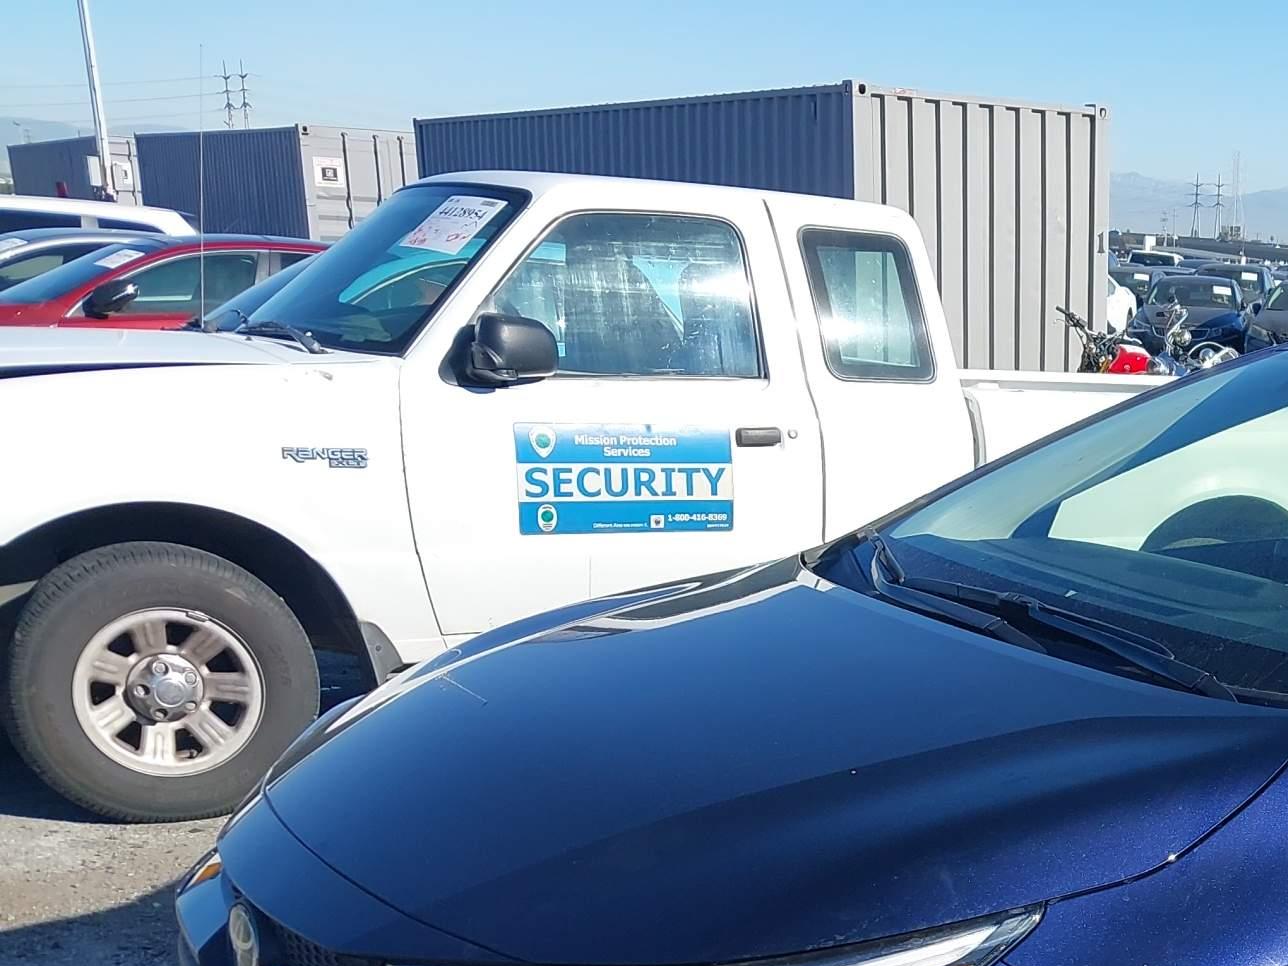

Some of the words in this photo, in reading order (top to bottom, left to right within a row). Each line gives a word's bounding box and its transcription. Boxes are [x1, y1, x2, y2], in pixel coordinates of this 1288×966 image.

[575, 434, 617, 446] Mission
[619, 434, 676, 446] Protection
[281, 447, 368, 463] RANGER
[603, 447, 651, 458] Services
[524, 467, 726, 498] SECURITY
